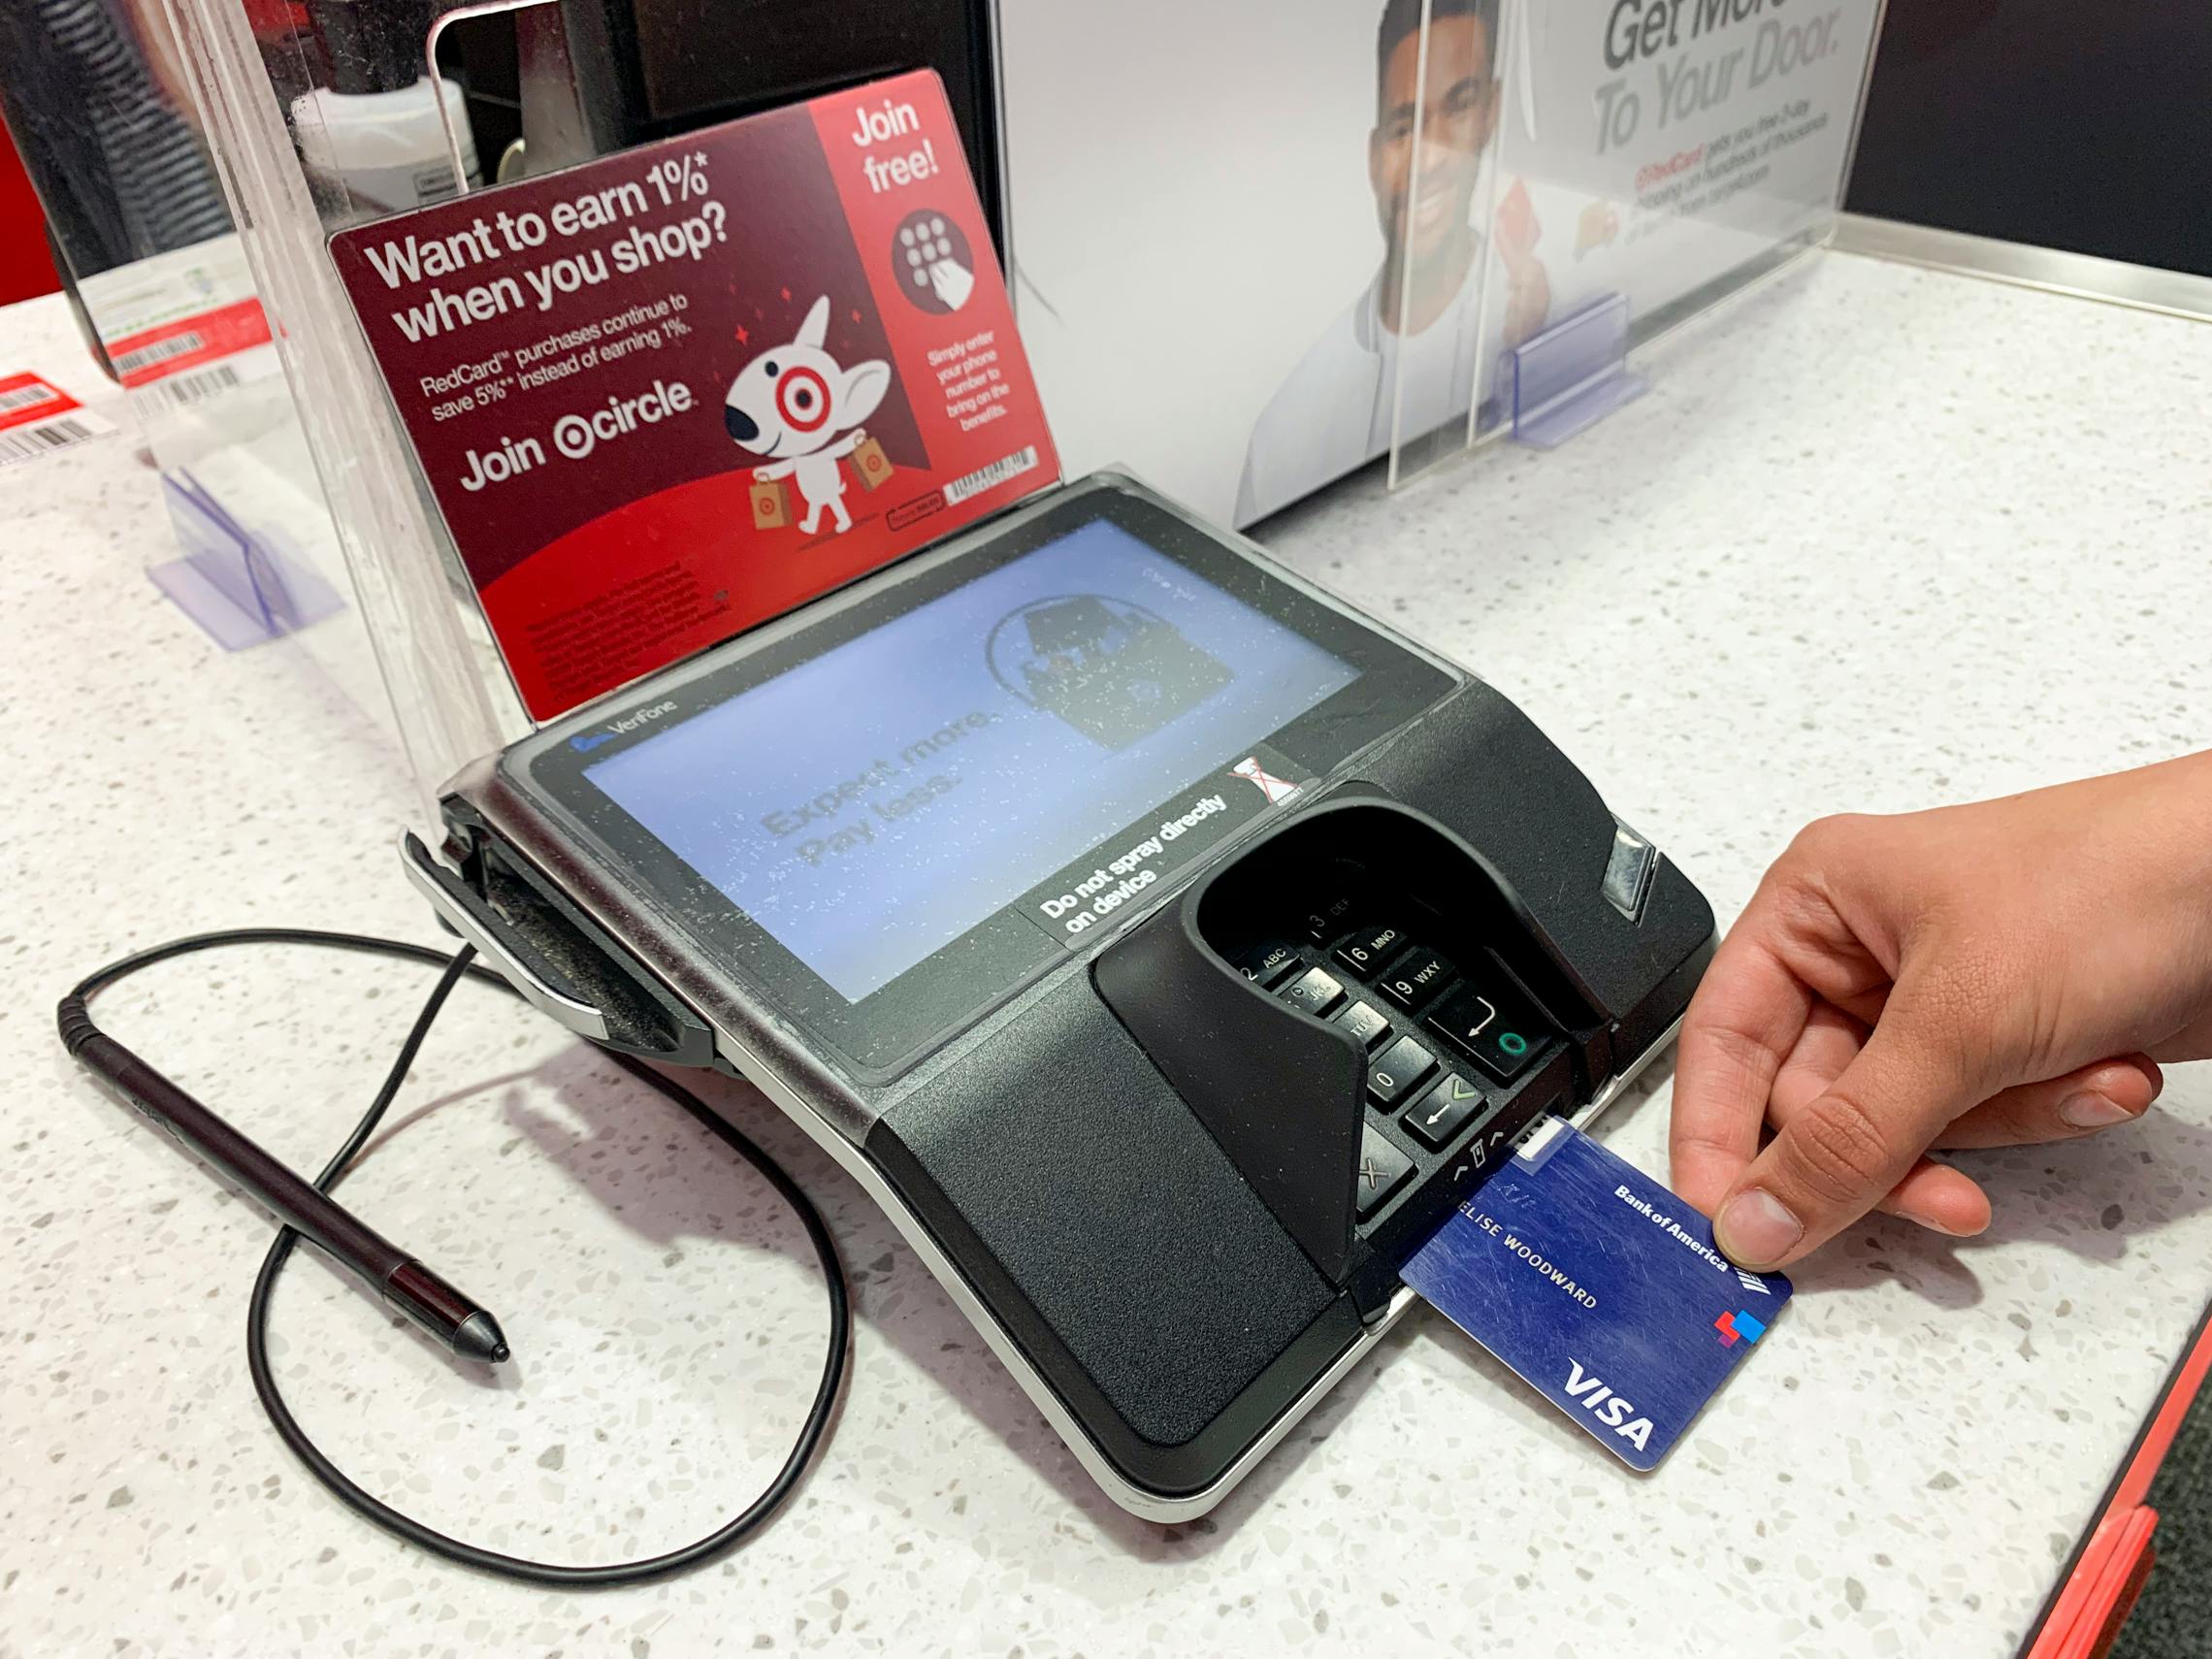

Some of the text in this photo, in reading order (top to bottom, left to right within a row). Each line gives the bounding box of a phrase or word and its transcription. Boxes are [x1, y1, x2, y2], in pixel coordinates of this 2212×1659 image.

[1604, 0, 1683, 71] Get
[1594, 8, 1841, 155] To Your Door.
[852, 98, 921, 147] Join
[862, 138, 939, 194] free!
[364, 217, 501, 289] Want
[496, 211, 547, 251] to
[550, 181, 649, 236] earn
[392, 200, 728, 343] when you shop?
[514, 322, 602, 369] purchases
[602, 298, 670, 336] continue
[668, 293, 689, 310] to
[927, 330, 994, 367] Simply enter
[432, 393, 474, 422] save
[515, 353, 581, 390] instead
[580, 344, 602, 369] of
[600, 328, 662, 362] earning
[661, 317, 693, 341] 1%.
[936, 349, 997, 386] your phone
[945, 368, 1001, 400] number to
[946, 383, 1010, 418] bring on the
[460, 436, 546, 492] Join
[606, 700, 678, 734] VeriFone
[760, 760, 900, 838] Expect
[795, 817, 875, 866] Pay
[1039, 794, 1227, 920] Do not spray directly
[1064, 868, 1158, 934] on device
[1309, 914, 1326, 927] 3
[1241, 947, 1287, 982] 2 ABC
[1350, 928, 1396, 961] 6 MNO
[1395, 960, 1442, 995] 9 WXY
[1350, 1015, 1375, 1037] TUV
[1375, 1071, 1395, 1088] 0
[1457, 1199, 1598, 1310] ELISE WOODWARD
[1613, 1184, 1730, 1273] Bank of America
[1559, 1356, 1655, 1453] VISA
